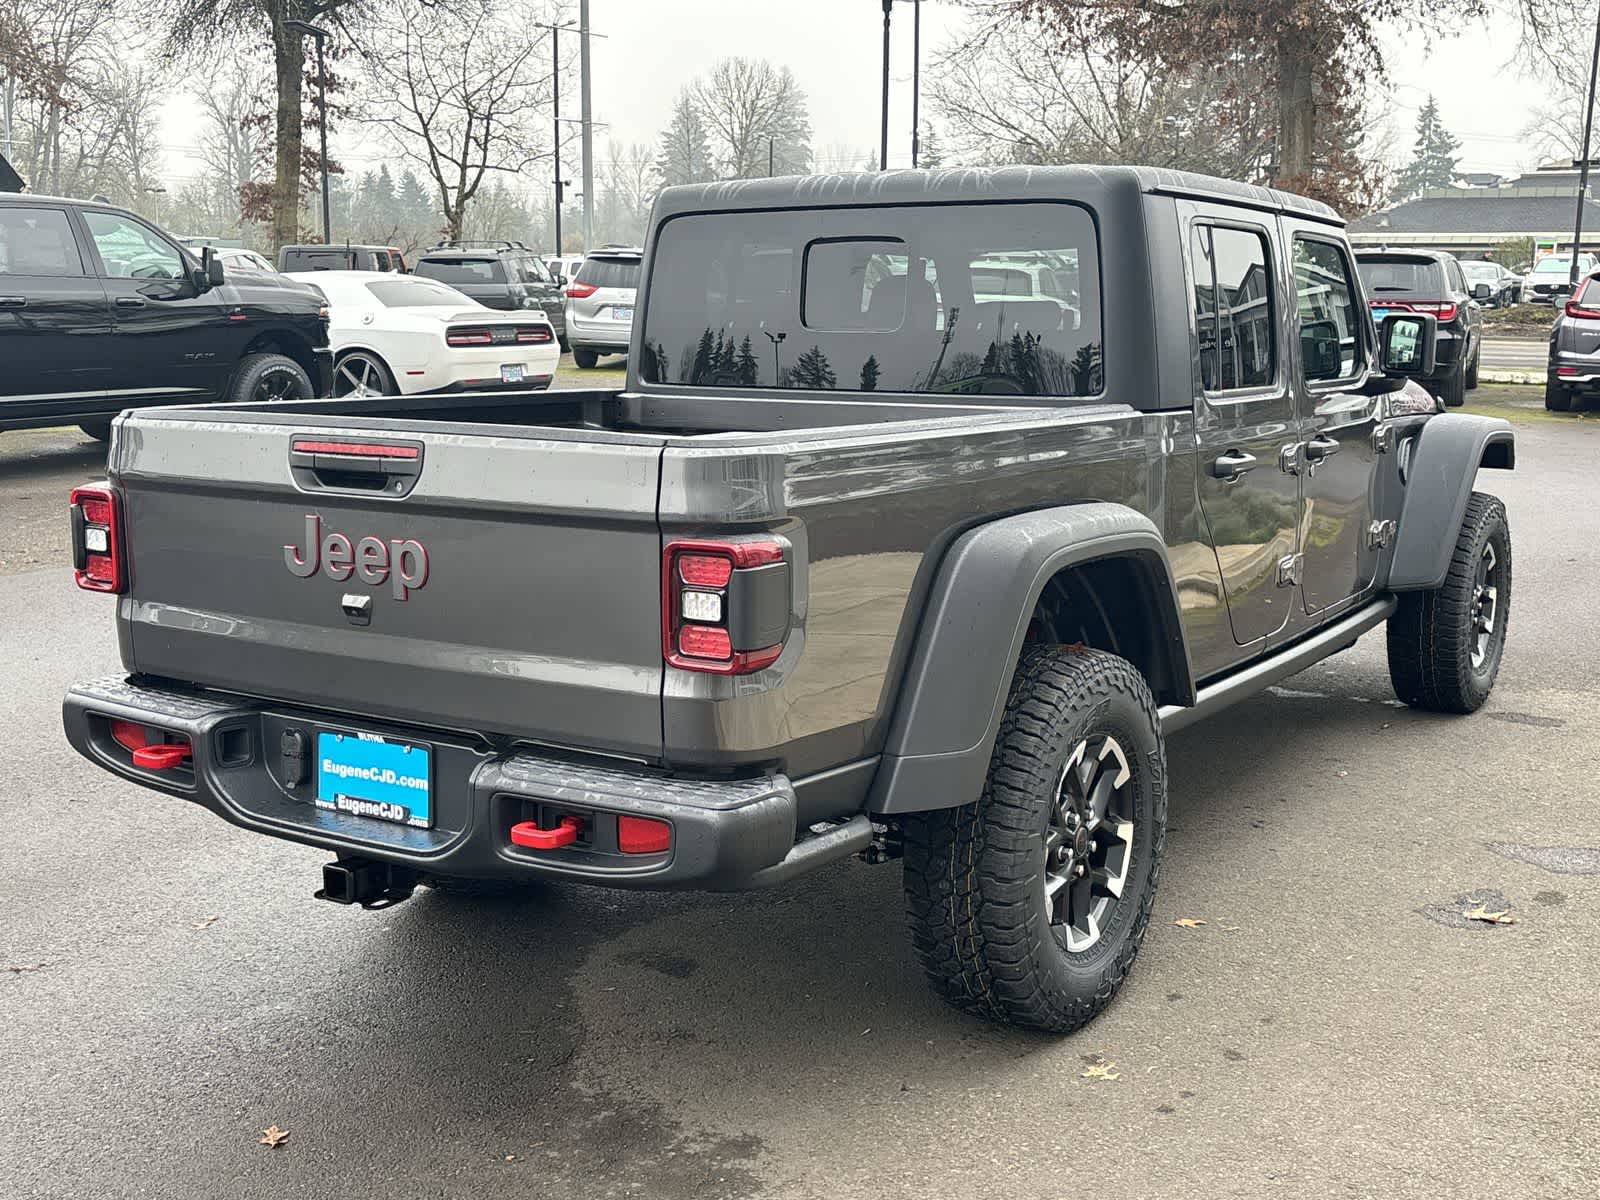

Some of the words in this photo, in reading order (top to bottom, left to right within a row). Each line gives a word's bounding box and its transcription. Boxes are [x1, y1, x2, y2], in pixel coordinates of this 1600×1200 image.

[283, 513, 429, 601] Jeep
[322, 759, 429, 790] EugeneCJD.com
[337, 794, 404, 820] EugeneCJD
